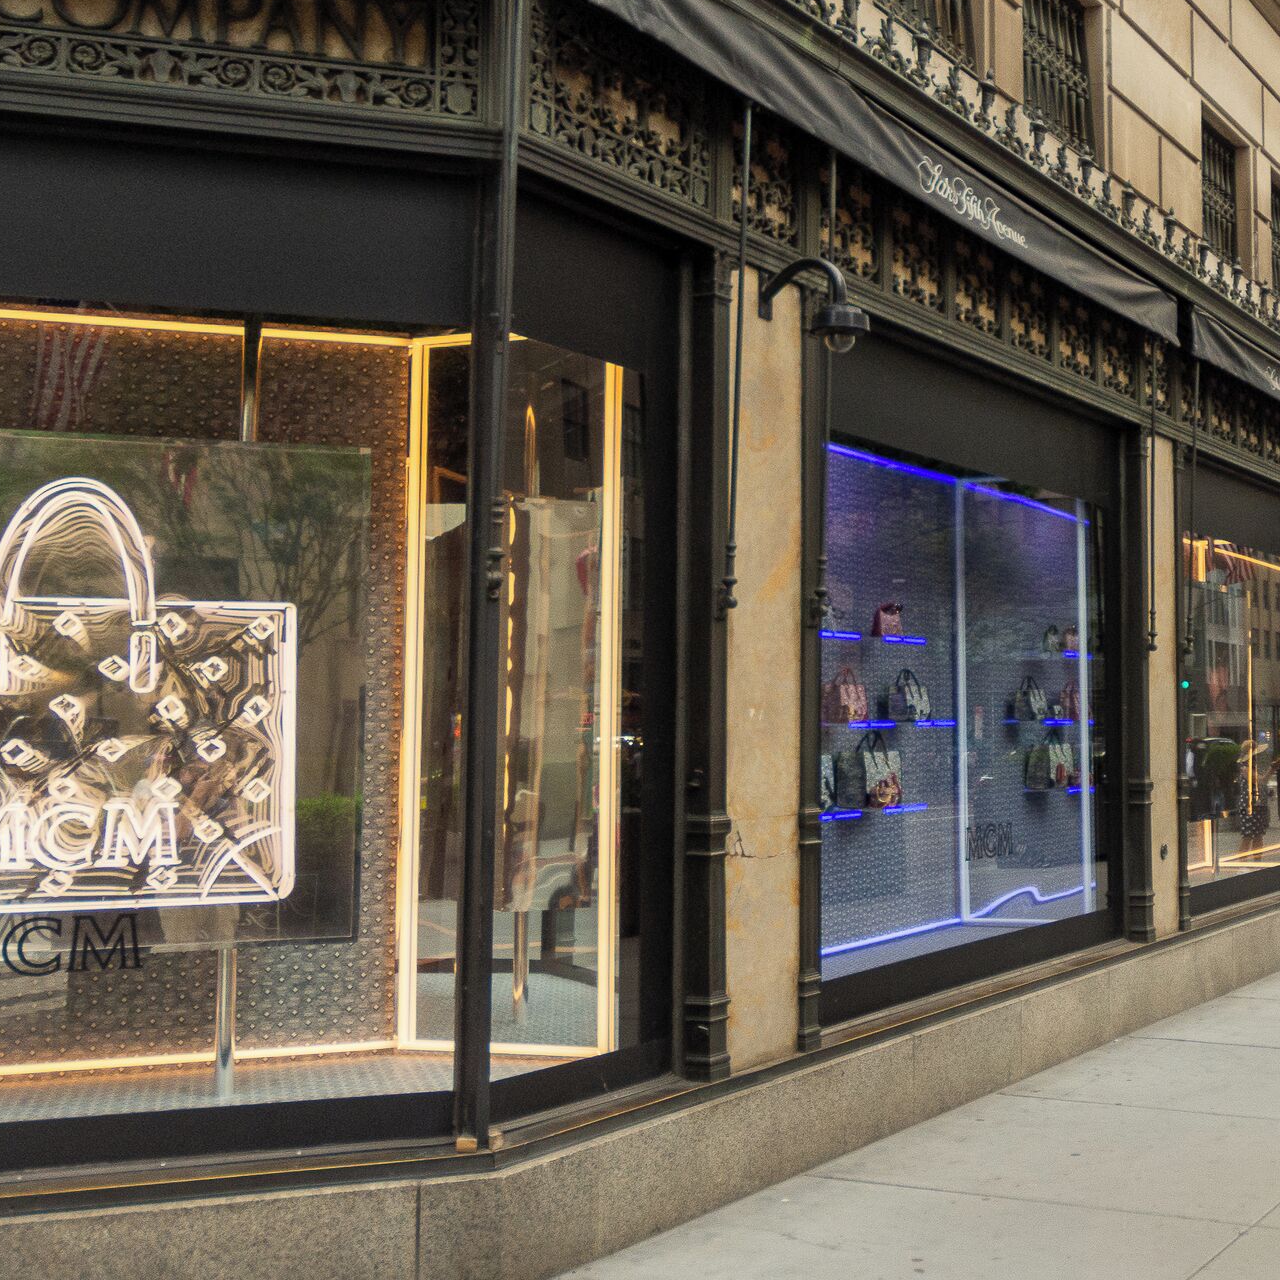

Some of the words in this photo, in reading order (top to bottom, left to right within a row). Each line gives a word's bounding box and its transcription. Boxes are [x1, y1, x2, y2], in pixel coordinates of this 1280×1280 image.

[918, 156, 959, 204] Saks
[953, 177, 987, 220] Fifth
[980, 197, 1028, 248] Avenue
[965, 822, 1012, 861] MCM
